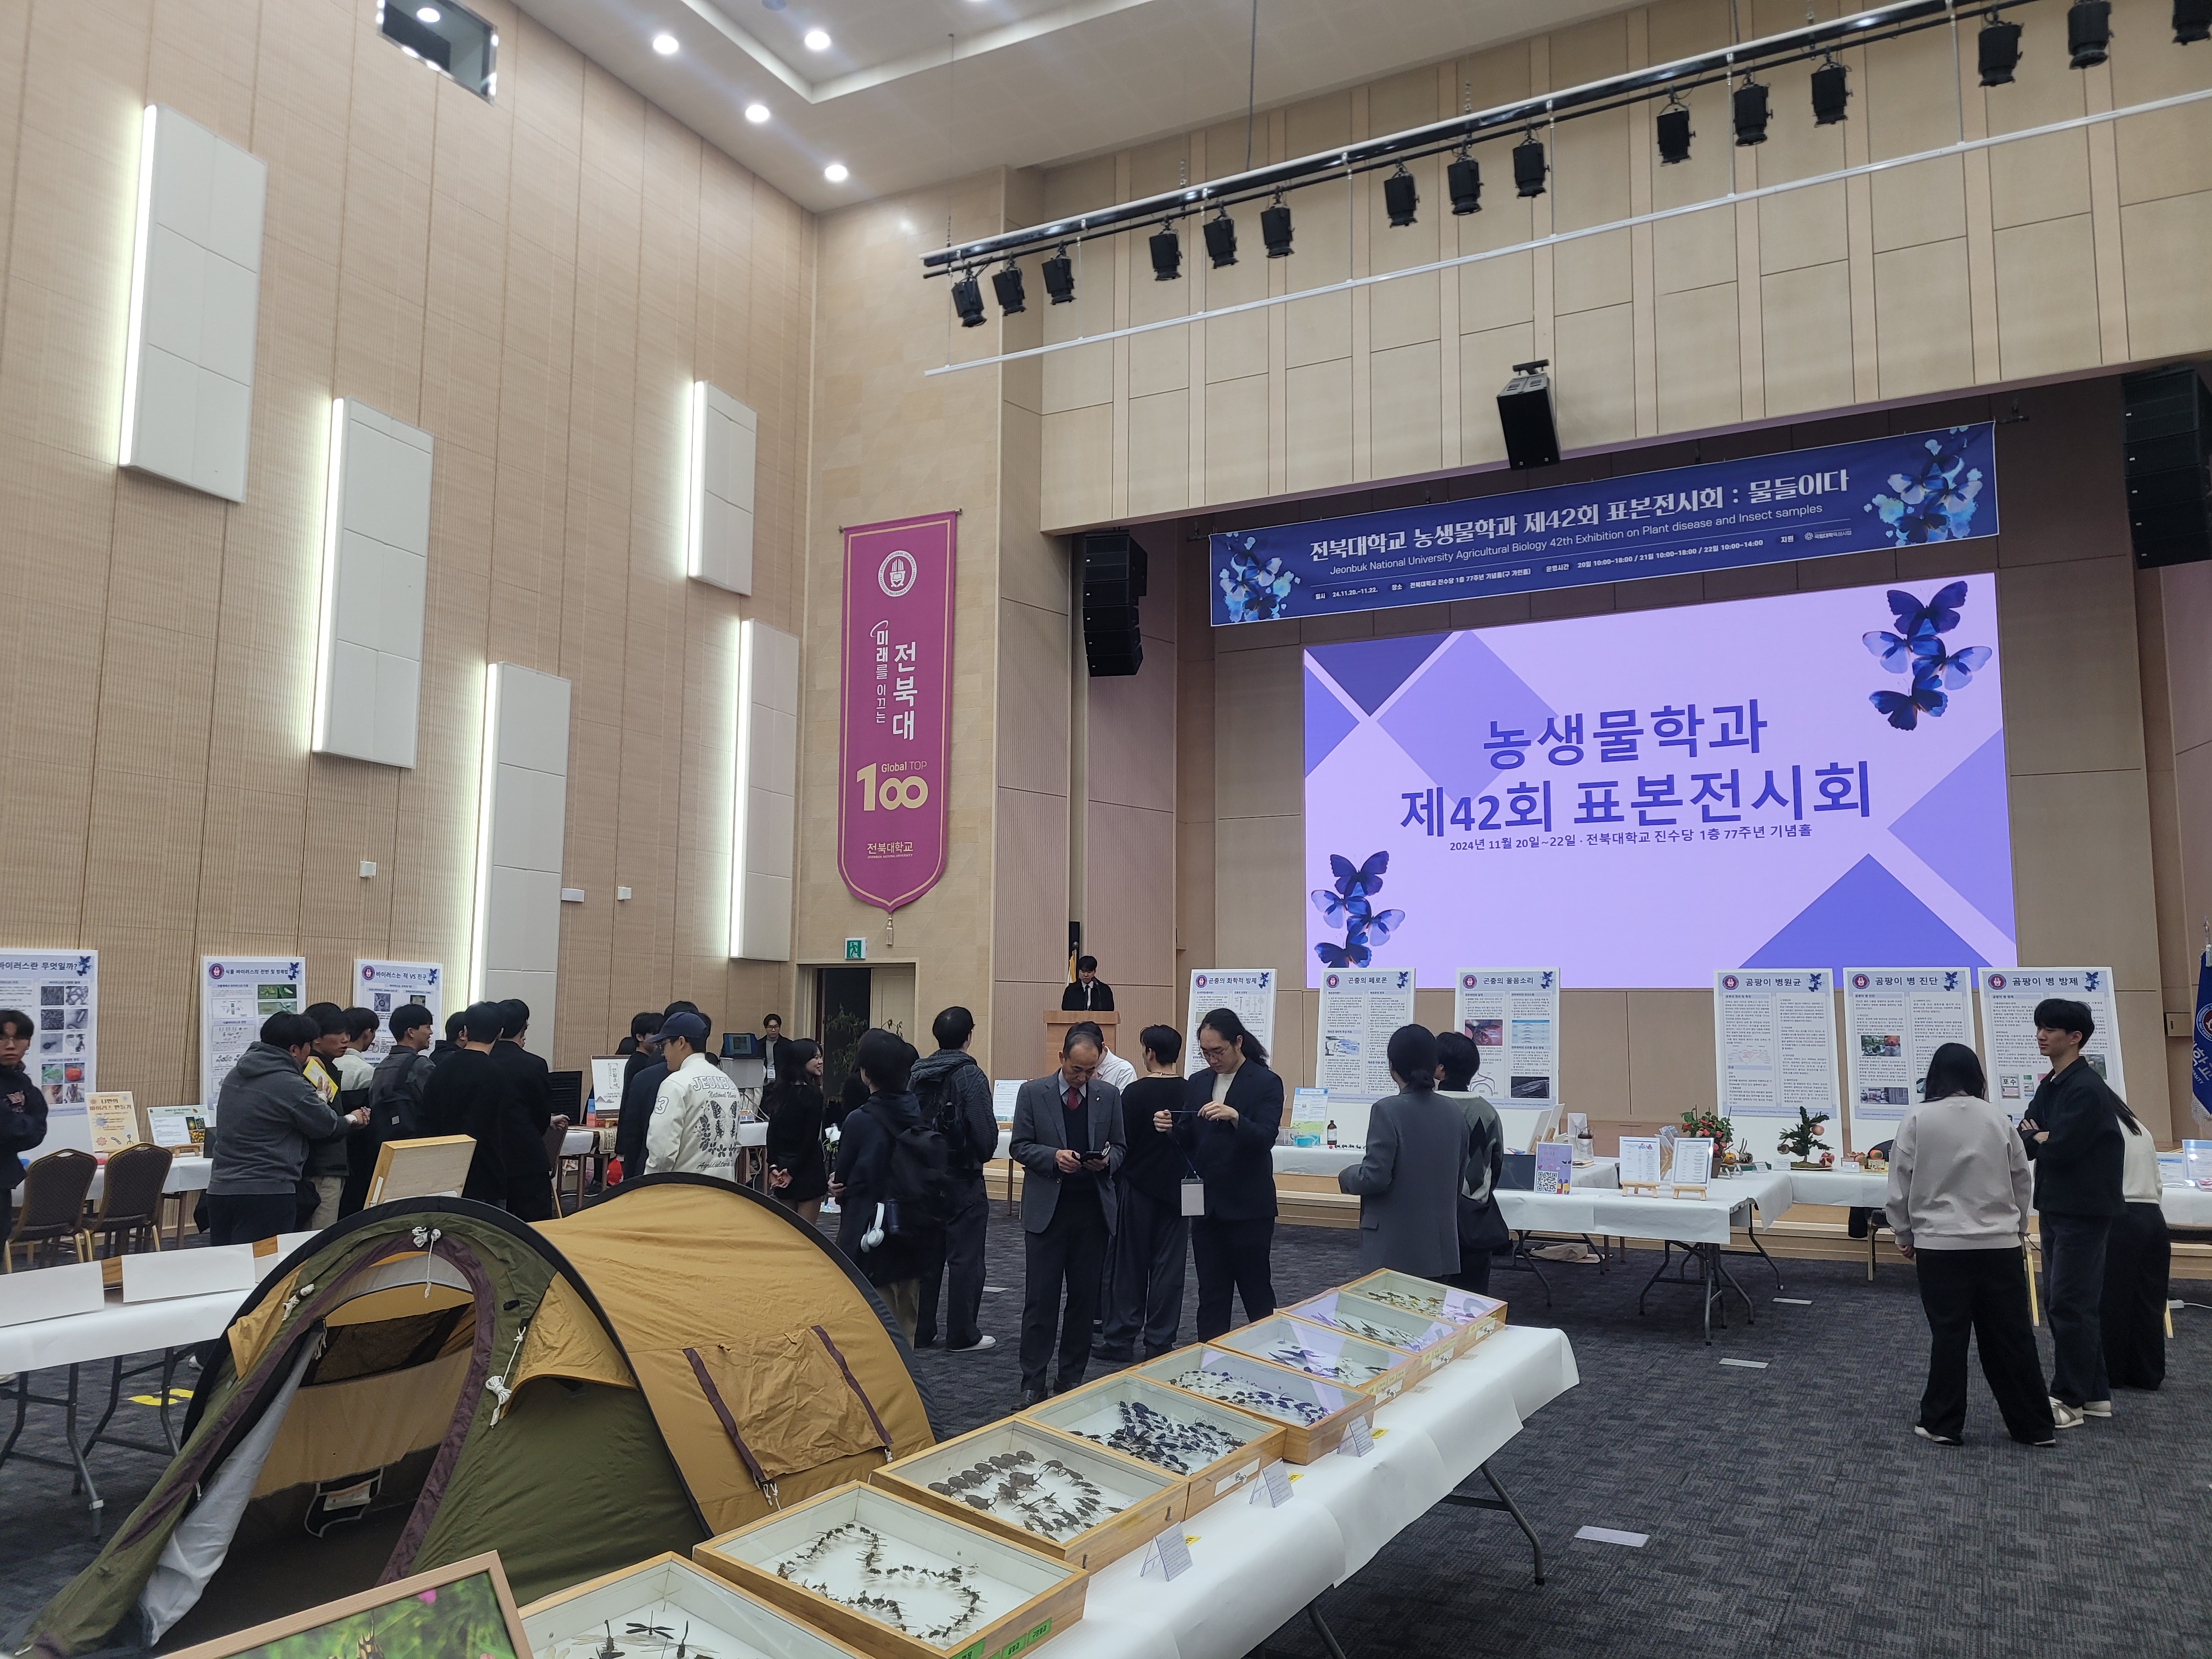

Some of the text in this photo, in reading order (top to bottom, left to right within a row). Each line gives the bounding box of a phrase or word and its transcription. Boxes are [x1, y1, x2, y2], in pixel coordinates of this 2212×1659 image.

[1310, 469, 1849, 562] 전북대학교 농생물학과 제42회 표본전시회 : 물들이다
[1330, 504, 1823, 575] Jeonbuk National University Agricultural Biology 42th Exhibition on Plant disease and Insect samples
[1410, 578, 1437, 589] 전북대학교
[1437, 577, 1454, 586] 진수당
[1466, 574, 1484, 583] 77주년
[1546, 563, 1570, 572] 운영시간
[1704, 545, 1719, 553] 22일
[876, 630, 889, 723] 미래를 이끄는
[893, 641, 918, 741] 전북대
[1483, 698, 1768, 770] 농생물학과
[856, 763, 928, 811] 100
[881, 761, 927, 772] Global TOP
[1400, 761, 1871, 837] 제42회 표본전시회
[867, 842, 913, 854] 전북대학교
[1449, 823, 1813, 851] 2024년 11월 20일~22일 전북대학교 진수당 1층 77주년 기념홀
[41, 962, 78, 970] 무엇일까?
[1775, 978, 1801, 986] 병원균
[1875, 977, 1938, 985] 곰팡이 병 진단
[2012, 977, 2078, 986] 곰팡이 병 방제
